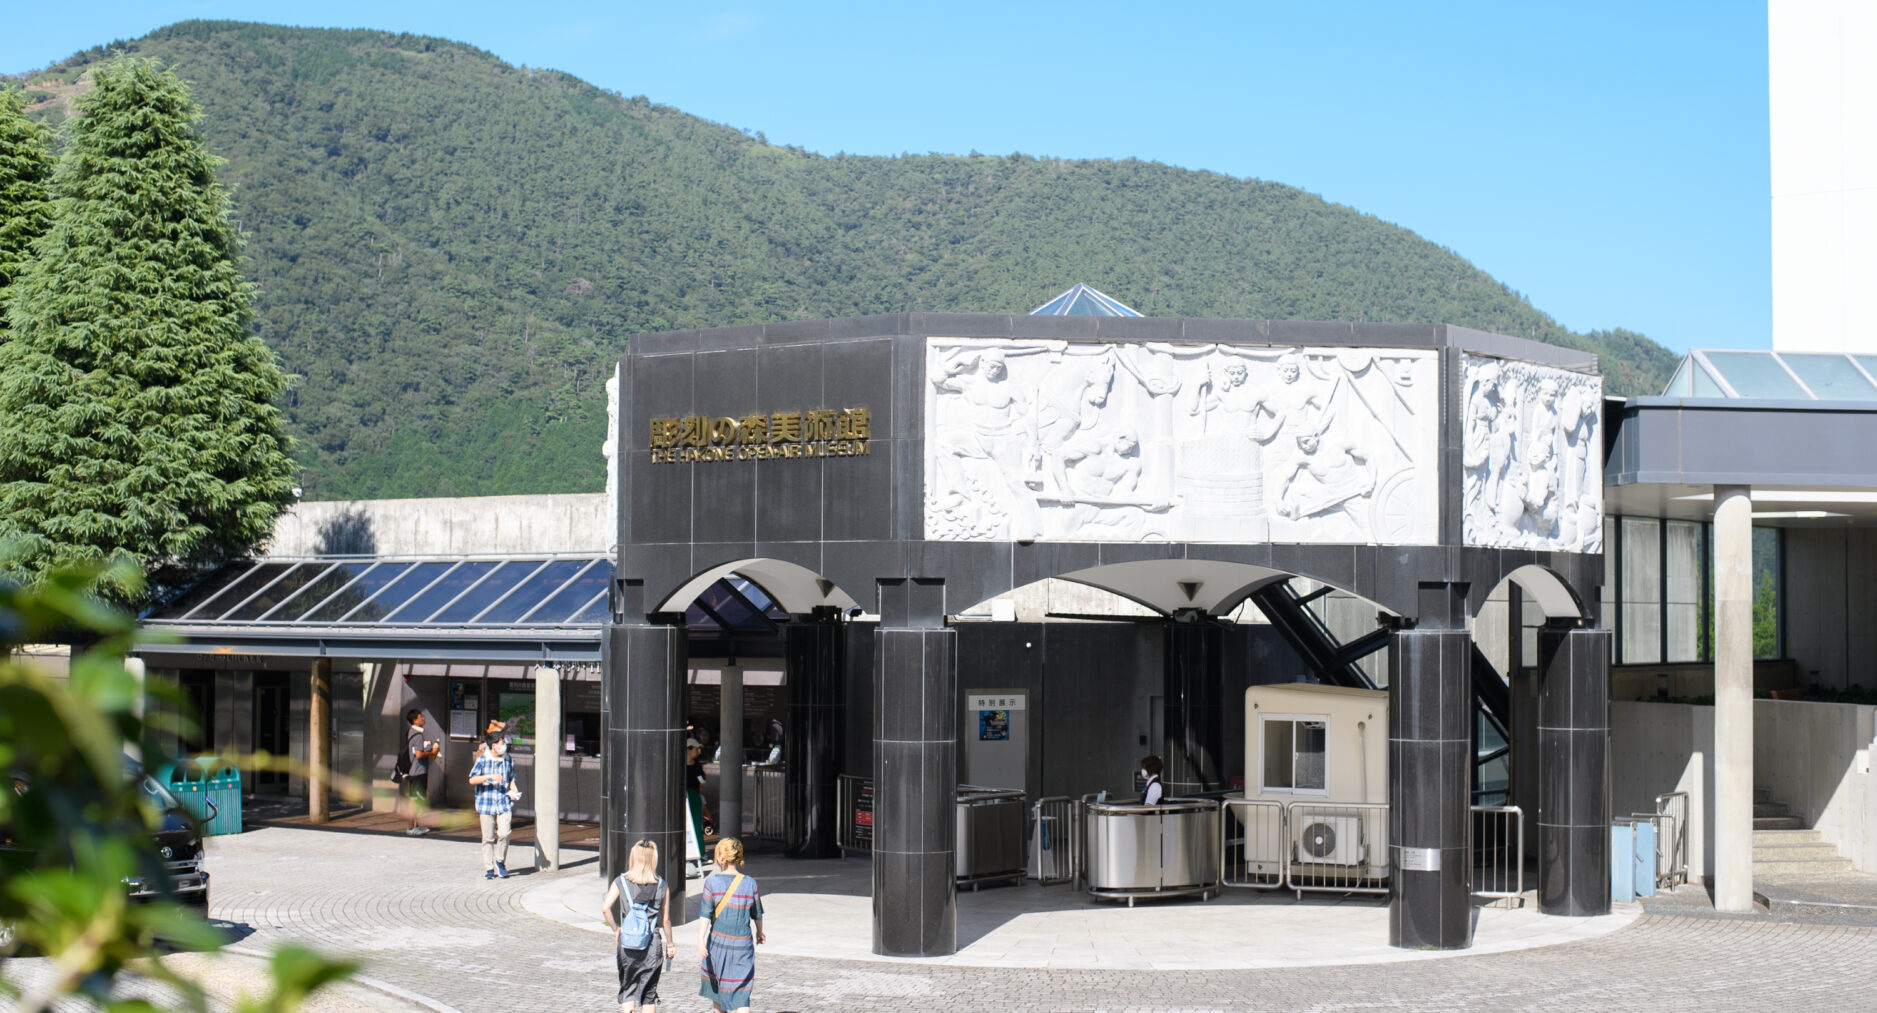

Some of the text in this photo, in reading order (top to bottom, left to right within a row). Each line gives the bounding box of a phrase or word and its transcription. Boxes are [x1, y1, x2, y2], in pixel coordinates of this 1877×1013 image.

[650, 408, 871, 447] 彫刻の森美術館
[651, 447, 676, 464] THE
[679, 445, 734, 463] HAKONE
[805, 440, 871, 457] MUSEUM
